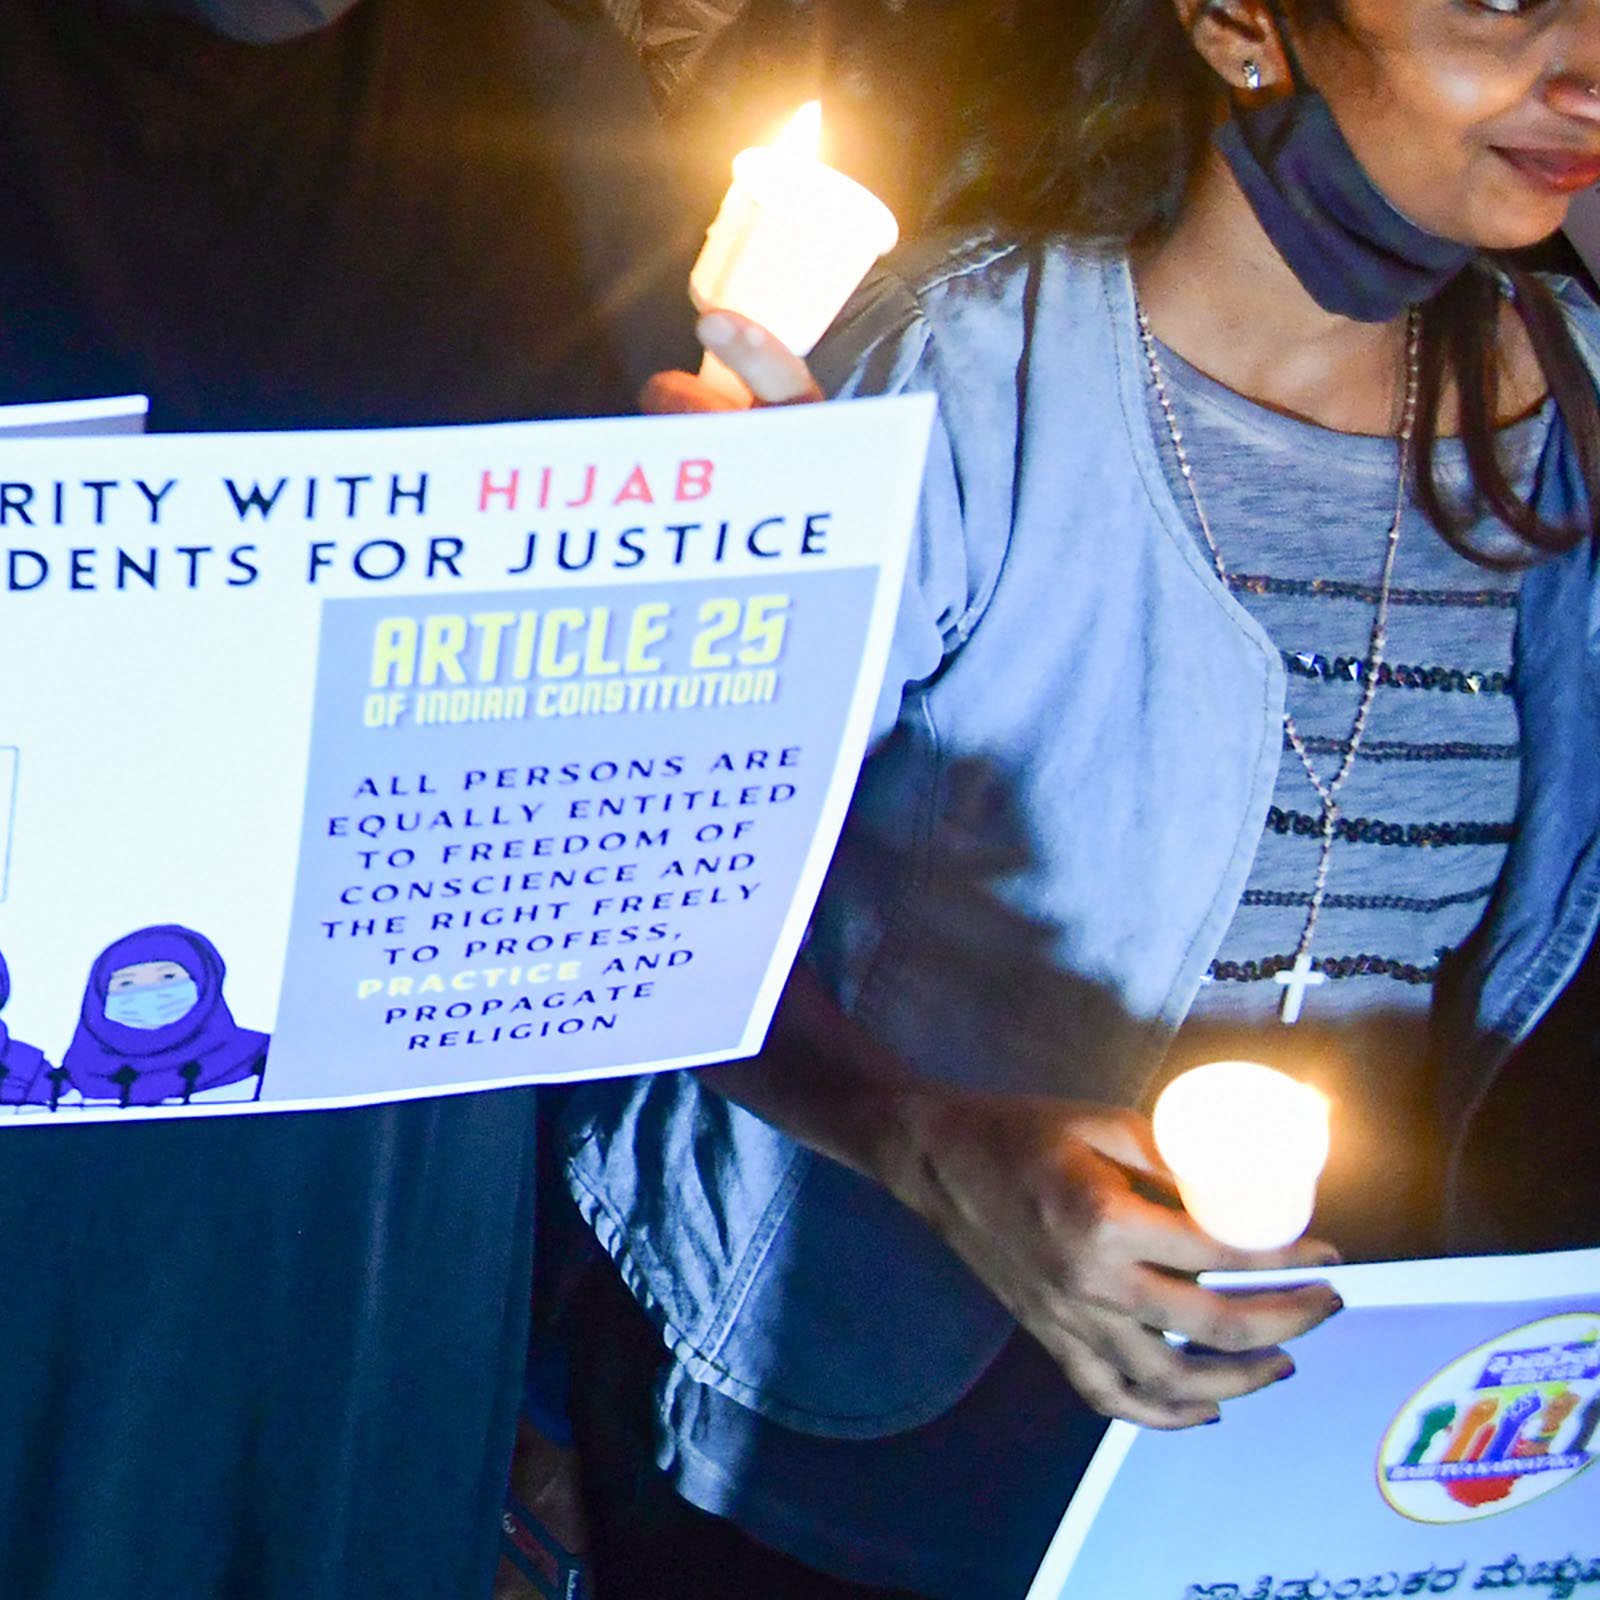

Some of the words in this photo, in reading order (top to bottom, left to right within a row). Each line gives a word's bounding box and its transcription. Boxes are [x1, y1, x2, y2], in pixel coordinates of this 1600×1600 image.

[221, 472, 430, 521] WITH
[476, 457, 717, 512] HIJAB
[307, 534, 468, 585] FOR
[507, 511, 835, 576] JUSTICE
[370, 602, 672, 689] ARTICLE
[690, 593, 792, 671] 25
[363, 691, 408, 729] OF
[414, 685, 527, 726] INDIAN
[536, 669, 778, 719] CONSTITUTION
[354, 773, 438, 800] ALL
[463, 755, 687, 792] PERSONS
[709, 745, 804, 775] ARE
[327, 802, 546, 840] EQUALLY
[567, 781, 799, 821] ENTITLED
[356, 847, 417, 871] TO
[441, 827, 673, 866] FREEDOM
[694, 819, 758, 844] OF
[339, 863, 640, 906] CONSCIENCE
[659, 851, 758, 880] AND
[321, 915, 408, 940] THE
[430, 901, 572, 932] RIGHT
[591, 881, 764, 918] FREELY
[383, 945, 441, 968] TO
[464, 921, 685, 960] PROFESS,
[356, 961, 583, 1000] PRACTICE
[601, 947, 696, 975] AND
[383, 981, 656, 1025] PROPAGATE
[406, 1013, 620, 1051] RELIGION
